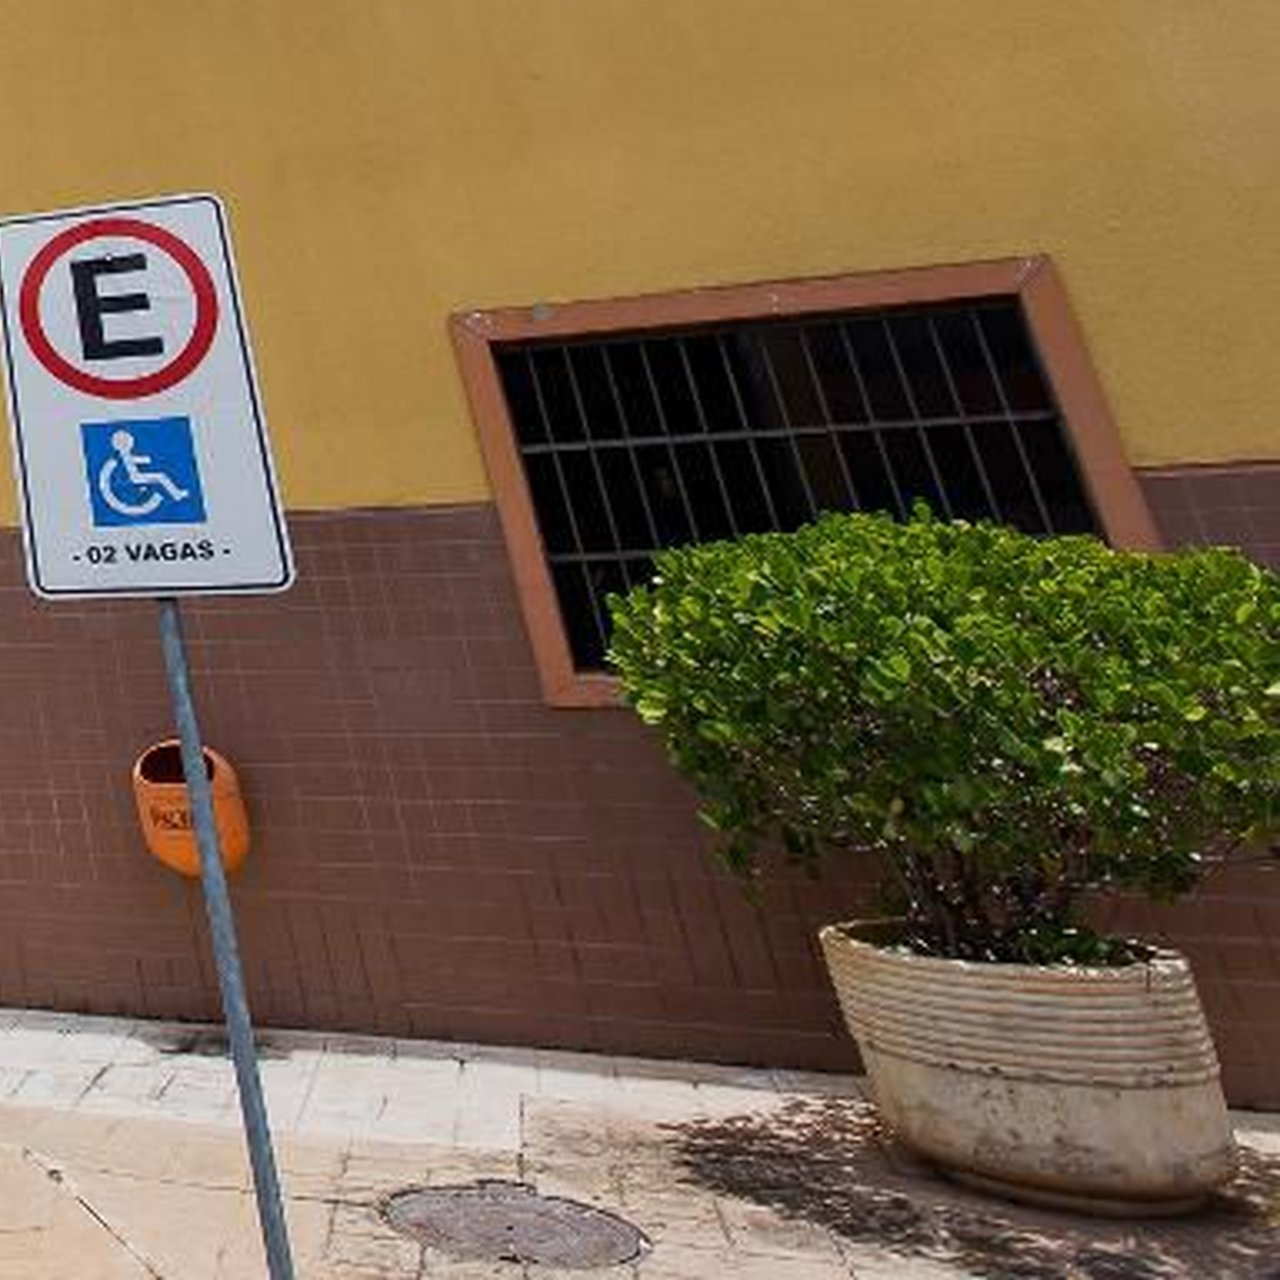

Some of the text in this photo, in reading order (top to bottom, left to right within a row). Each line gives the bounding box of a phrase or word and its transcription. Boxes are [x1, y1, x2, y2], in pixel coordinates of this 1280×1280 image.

[69, 252, 164, 361] E
[87, 546, 117, 564] 02
[125, 540, 215, 562] VAGAS
